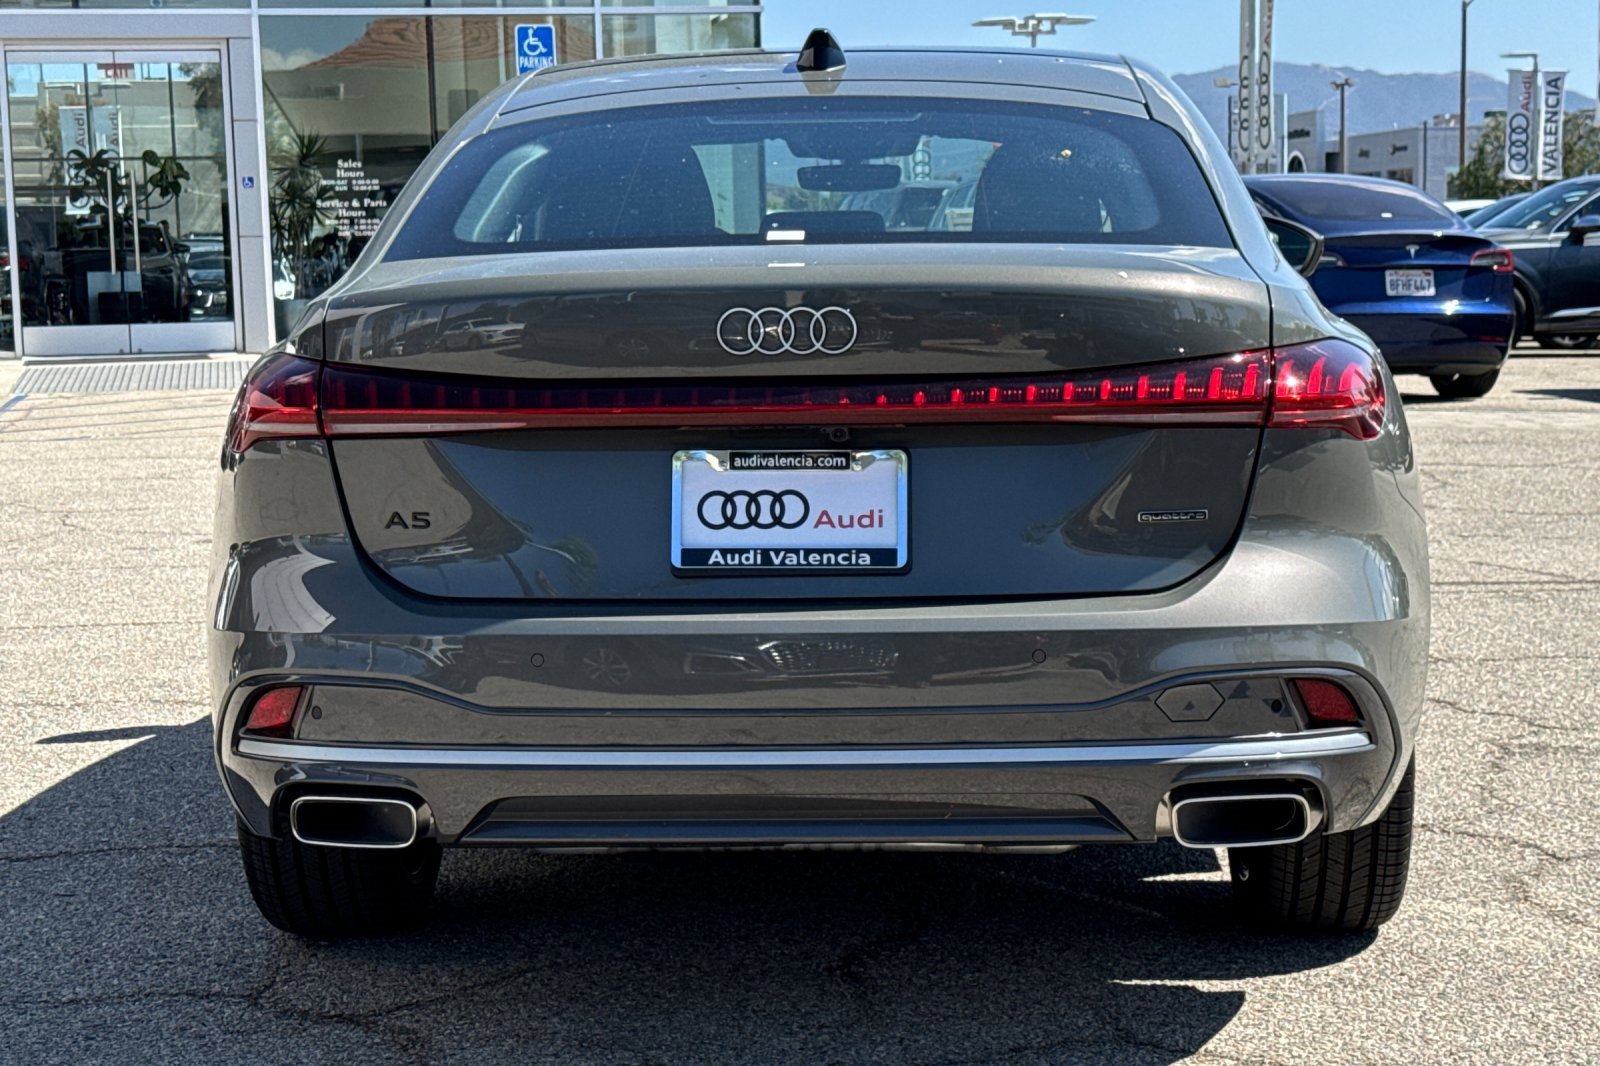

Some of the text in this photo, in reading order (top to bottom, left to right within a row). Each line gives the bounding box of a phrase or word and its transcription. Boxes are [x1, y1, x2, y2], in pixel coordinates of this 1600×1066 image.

[519, 56, 553, 68] PARKING
[1521, 74, 1532, 113] Audi
[73, 112, 86, 149] Audi
[1542, 76, 1562, 174] VALENCIA
[337, 159, 362, 168] Sales
[336, 169, 364, 177] Hours
[316, 198, 387, 208] Service & Parts
[338, 209, 366, 217] Hours
[733, 454, 847, 468] audivalencia.com
[384, 511, 431, 529] A5
[813, 509, 884, 529] Audi
[1141, 511, 1206, 522] quattro
[708, 549, 871, 566] Audi Valencia
